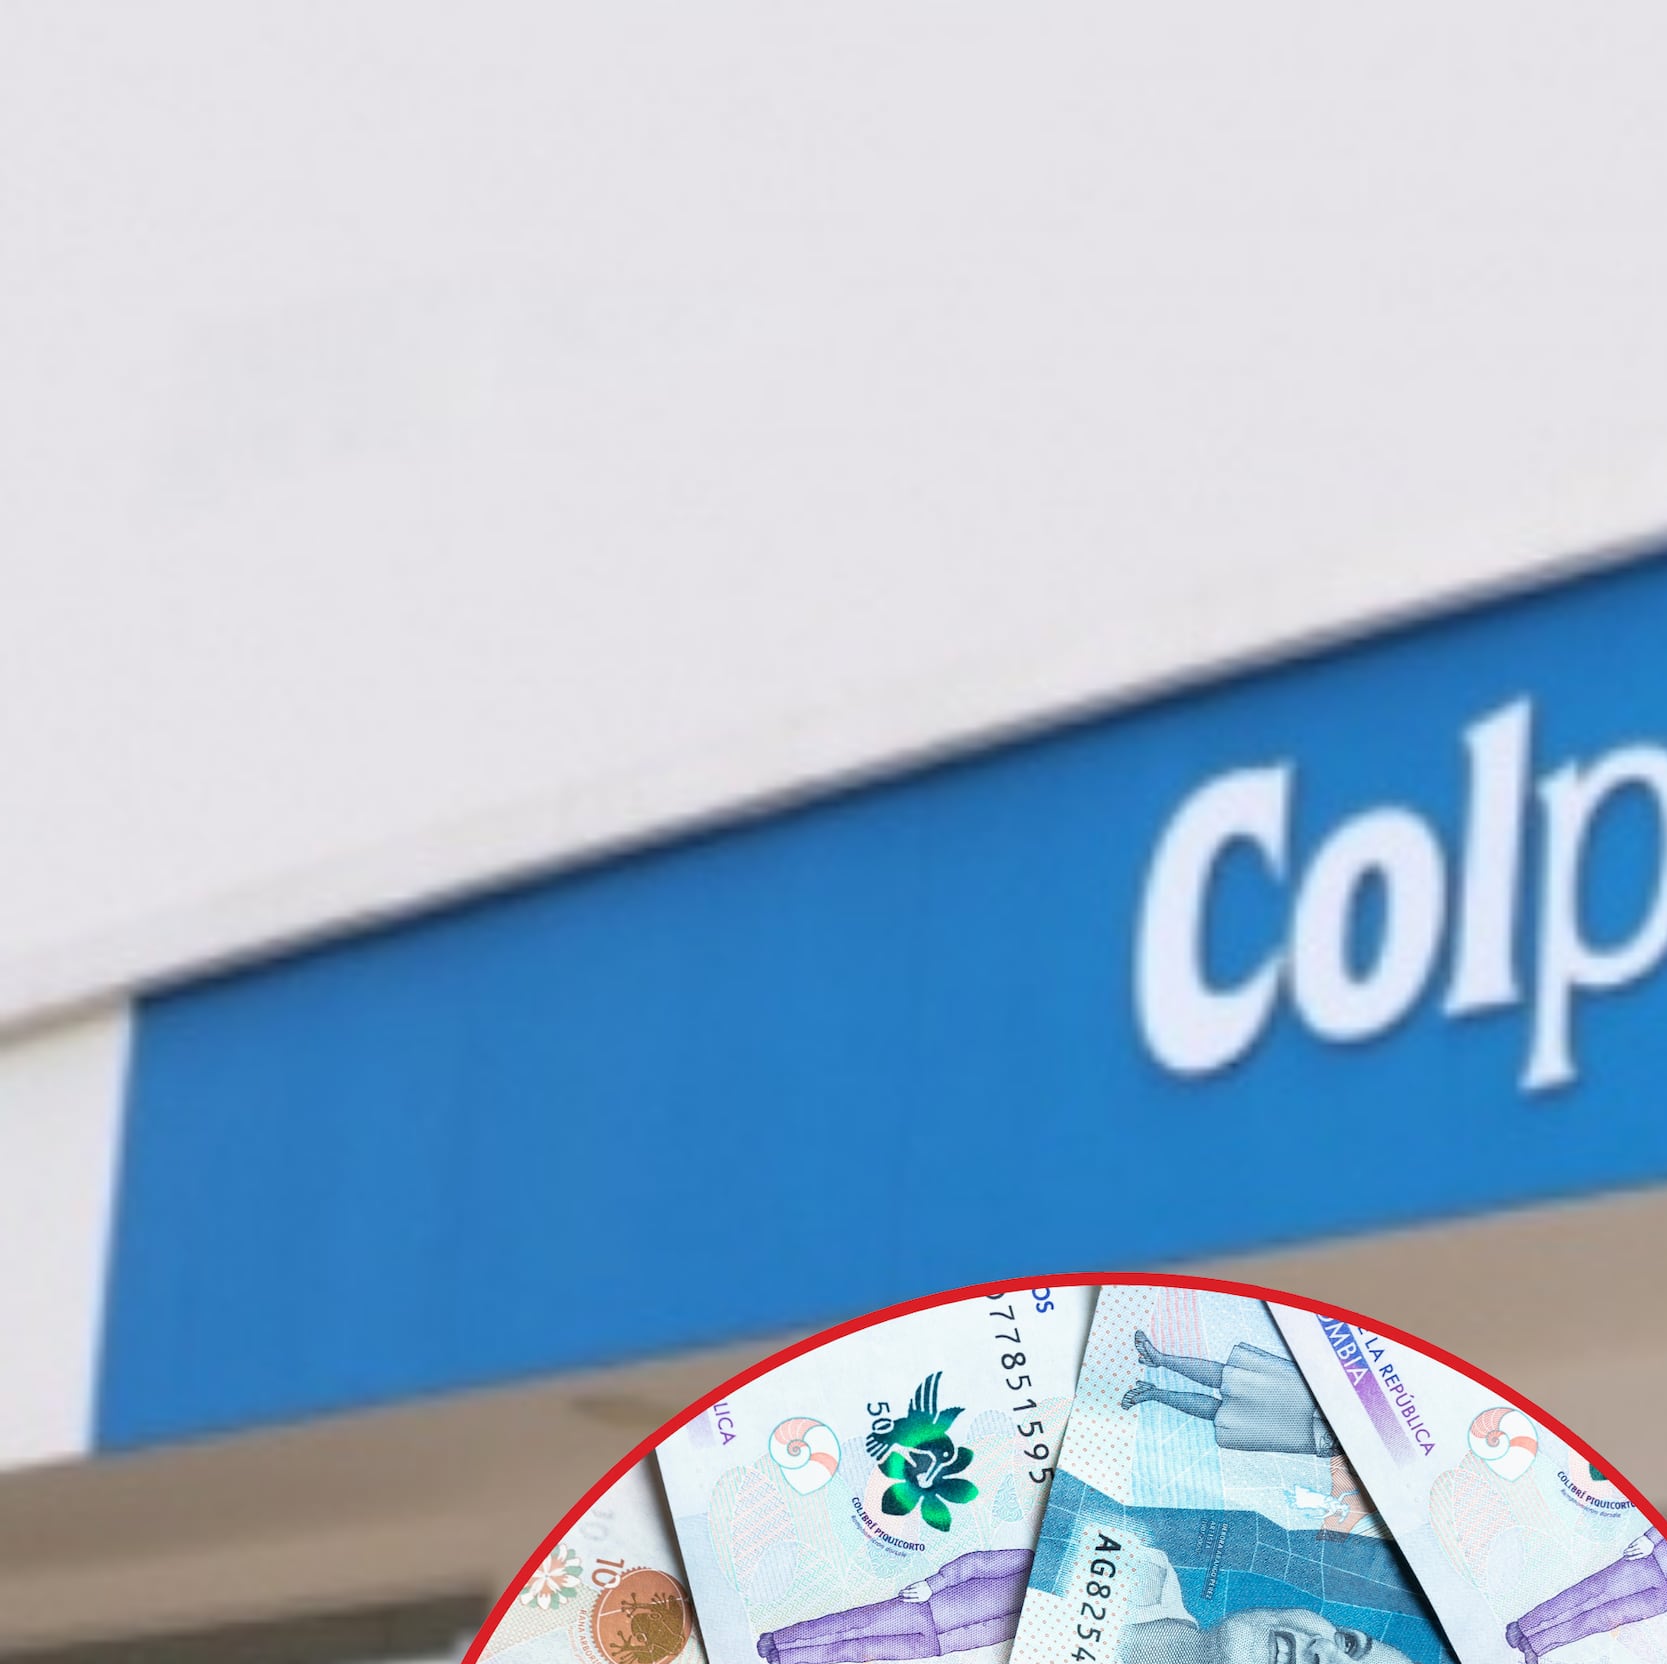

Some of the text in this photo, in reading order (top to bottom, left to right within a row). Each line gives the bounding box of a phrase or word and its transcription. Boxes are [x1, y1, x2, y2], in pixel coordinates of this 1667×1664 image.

[986, 1291, 1055, 1484] 77851595
[1365, 1337, 1436, 1456] LA REPÚBLICA
[713, 1402, 736, 1446] LICA
[867, 1401, 894, 1434] 50
[1557, 1471, 1588, 1499] COLIBRÍ
[851, 1496, 926, 1552] COLIBRÍ PIQUICORTO
[592, 1558, 625, 1588] 10
[578, 1609, 588, 1634] RANA
